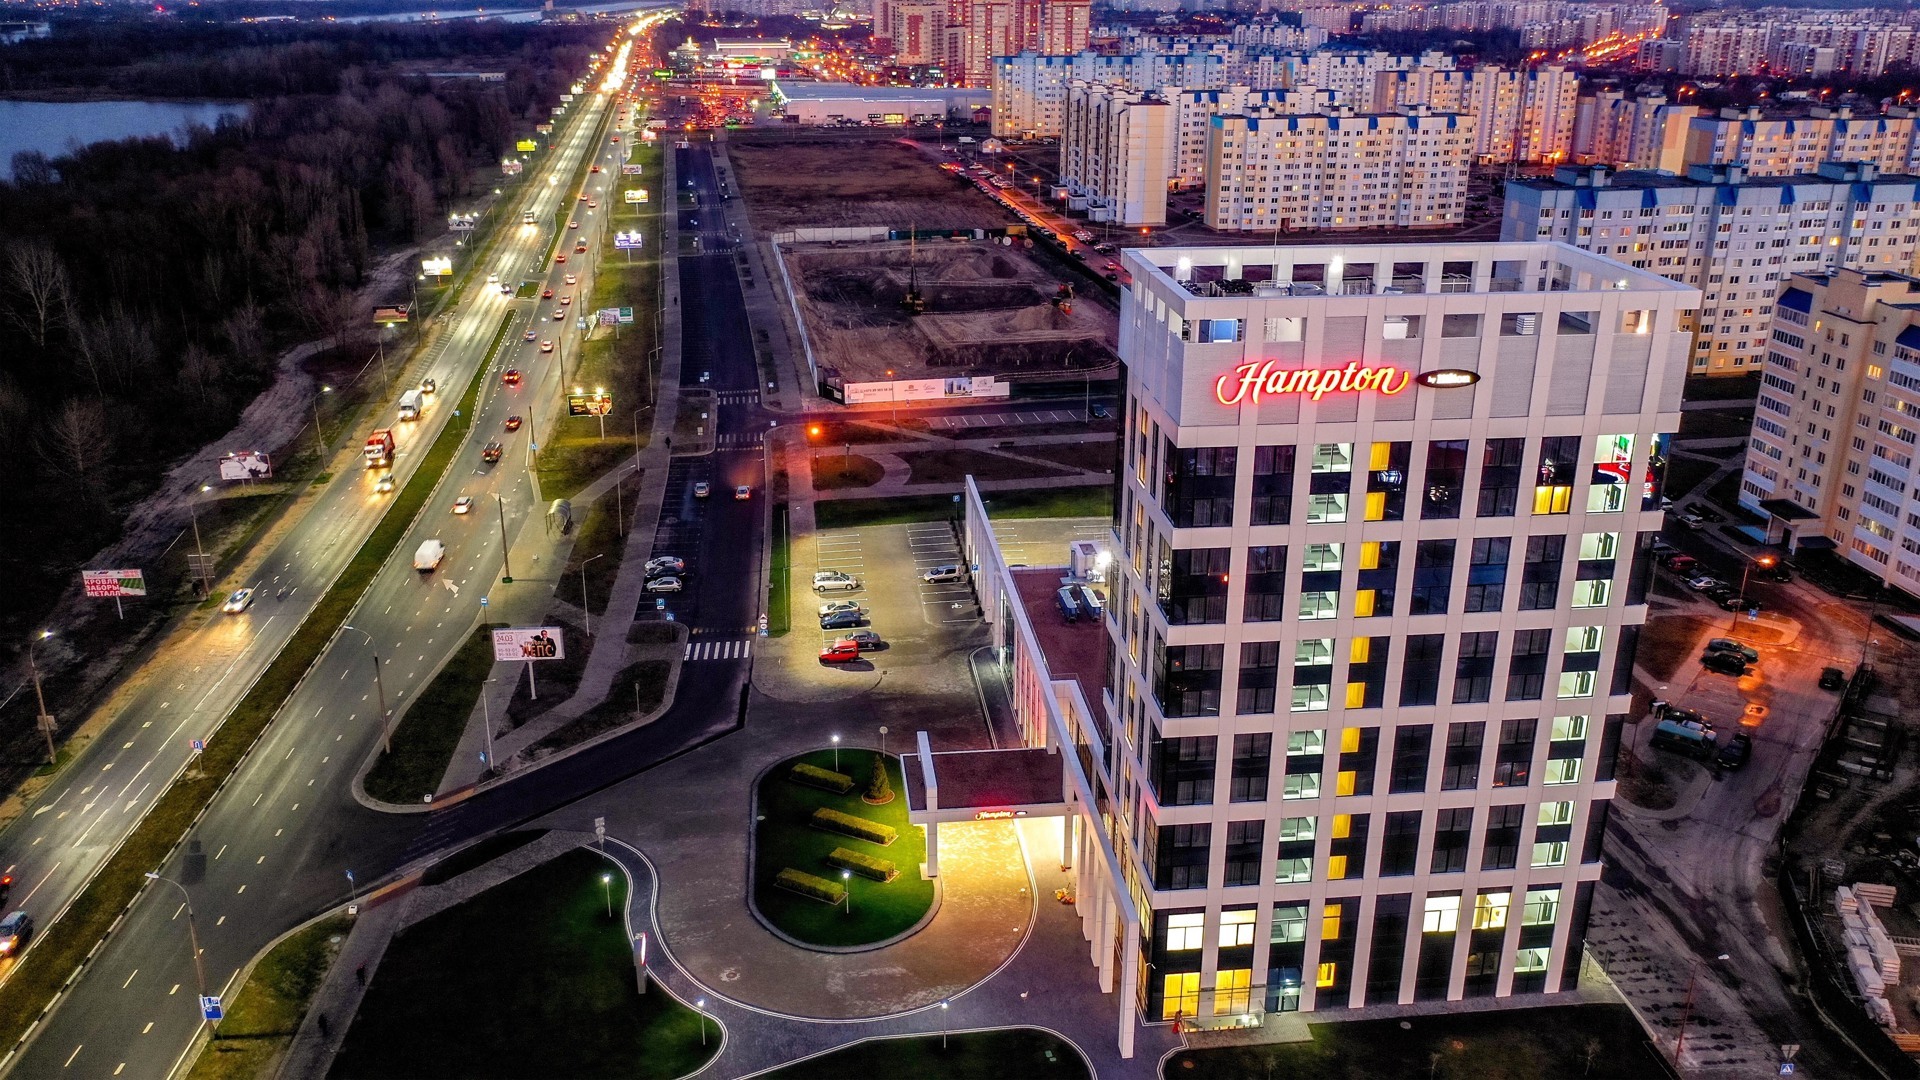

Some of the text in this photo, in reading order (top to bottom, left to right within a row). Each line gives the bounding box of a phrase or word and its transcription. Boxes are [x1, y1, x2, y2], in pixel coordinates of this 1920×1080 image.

[1216, 360, 1409, 405] Hampton
[522, 645, 552, 657] ЛЕПС
[975, 811, 1013, 820] Hampton
